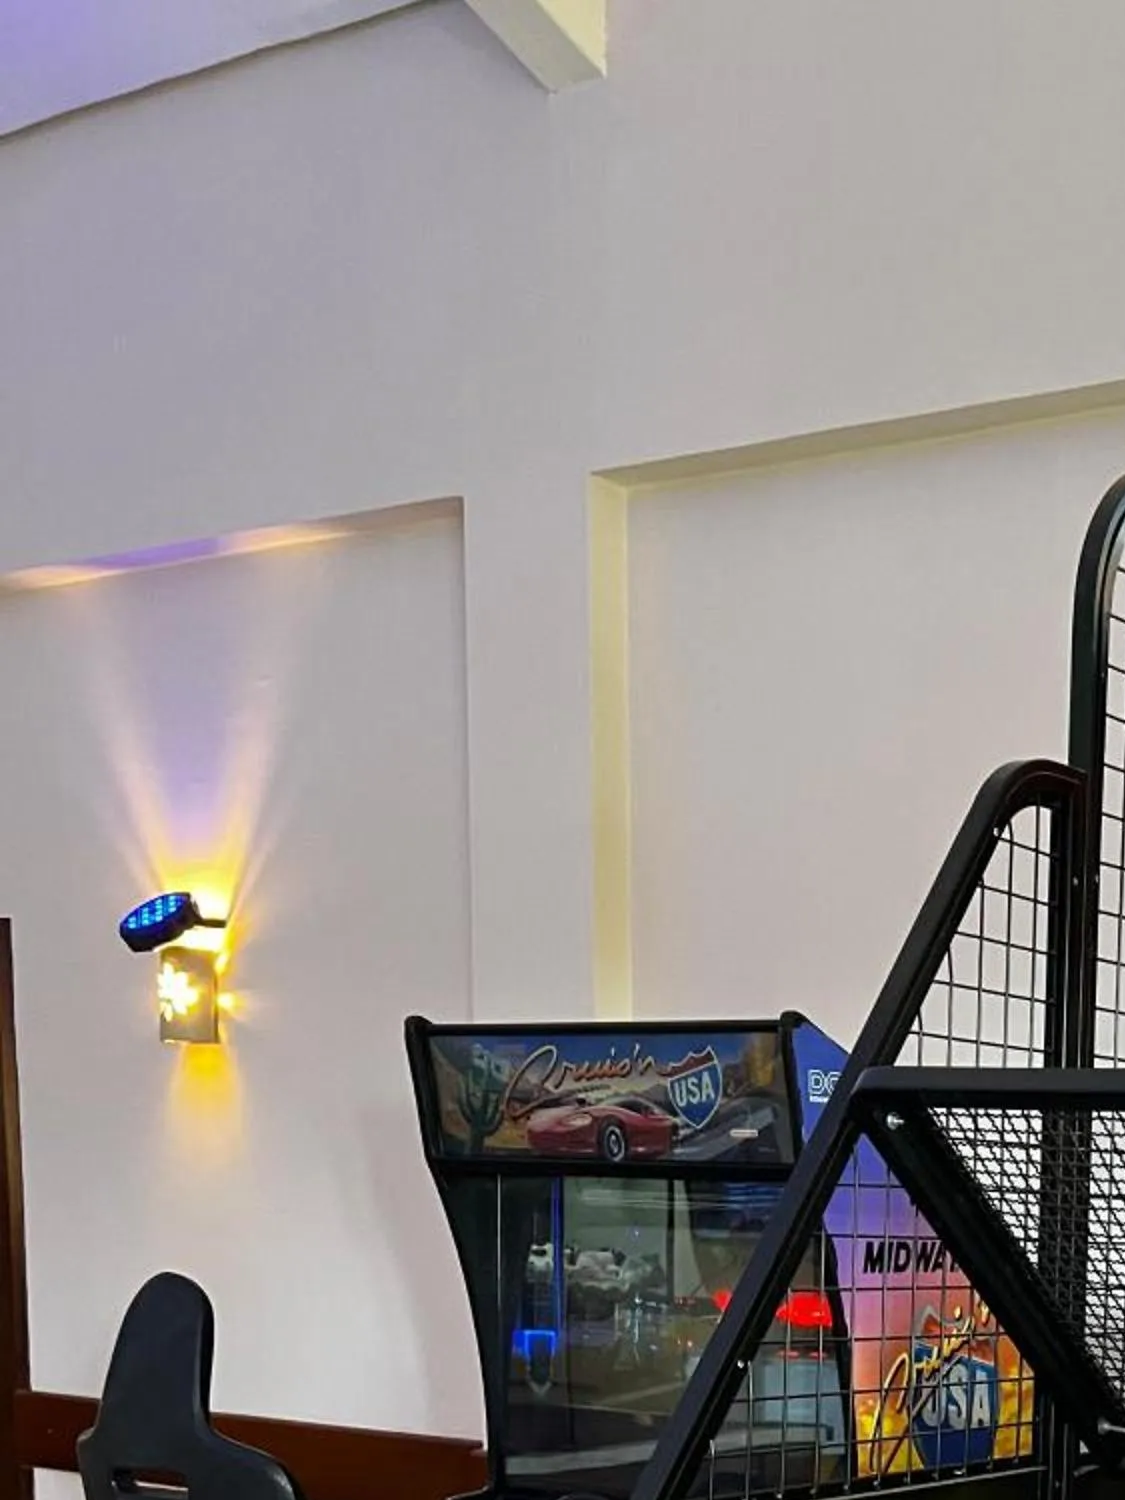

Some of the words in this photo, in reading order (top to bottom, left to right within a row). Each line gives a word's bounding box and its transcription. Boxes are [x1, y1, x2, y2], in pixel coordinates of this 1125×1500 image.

[673, 1071, 715, 1107] USA
[863, 1240, 959, 1275] MIDWA
[920, 1363, 992, 1428] USA
